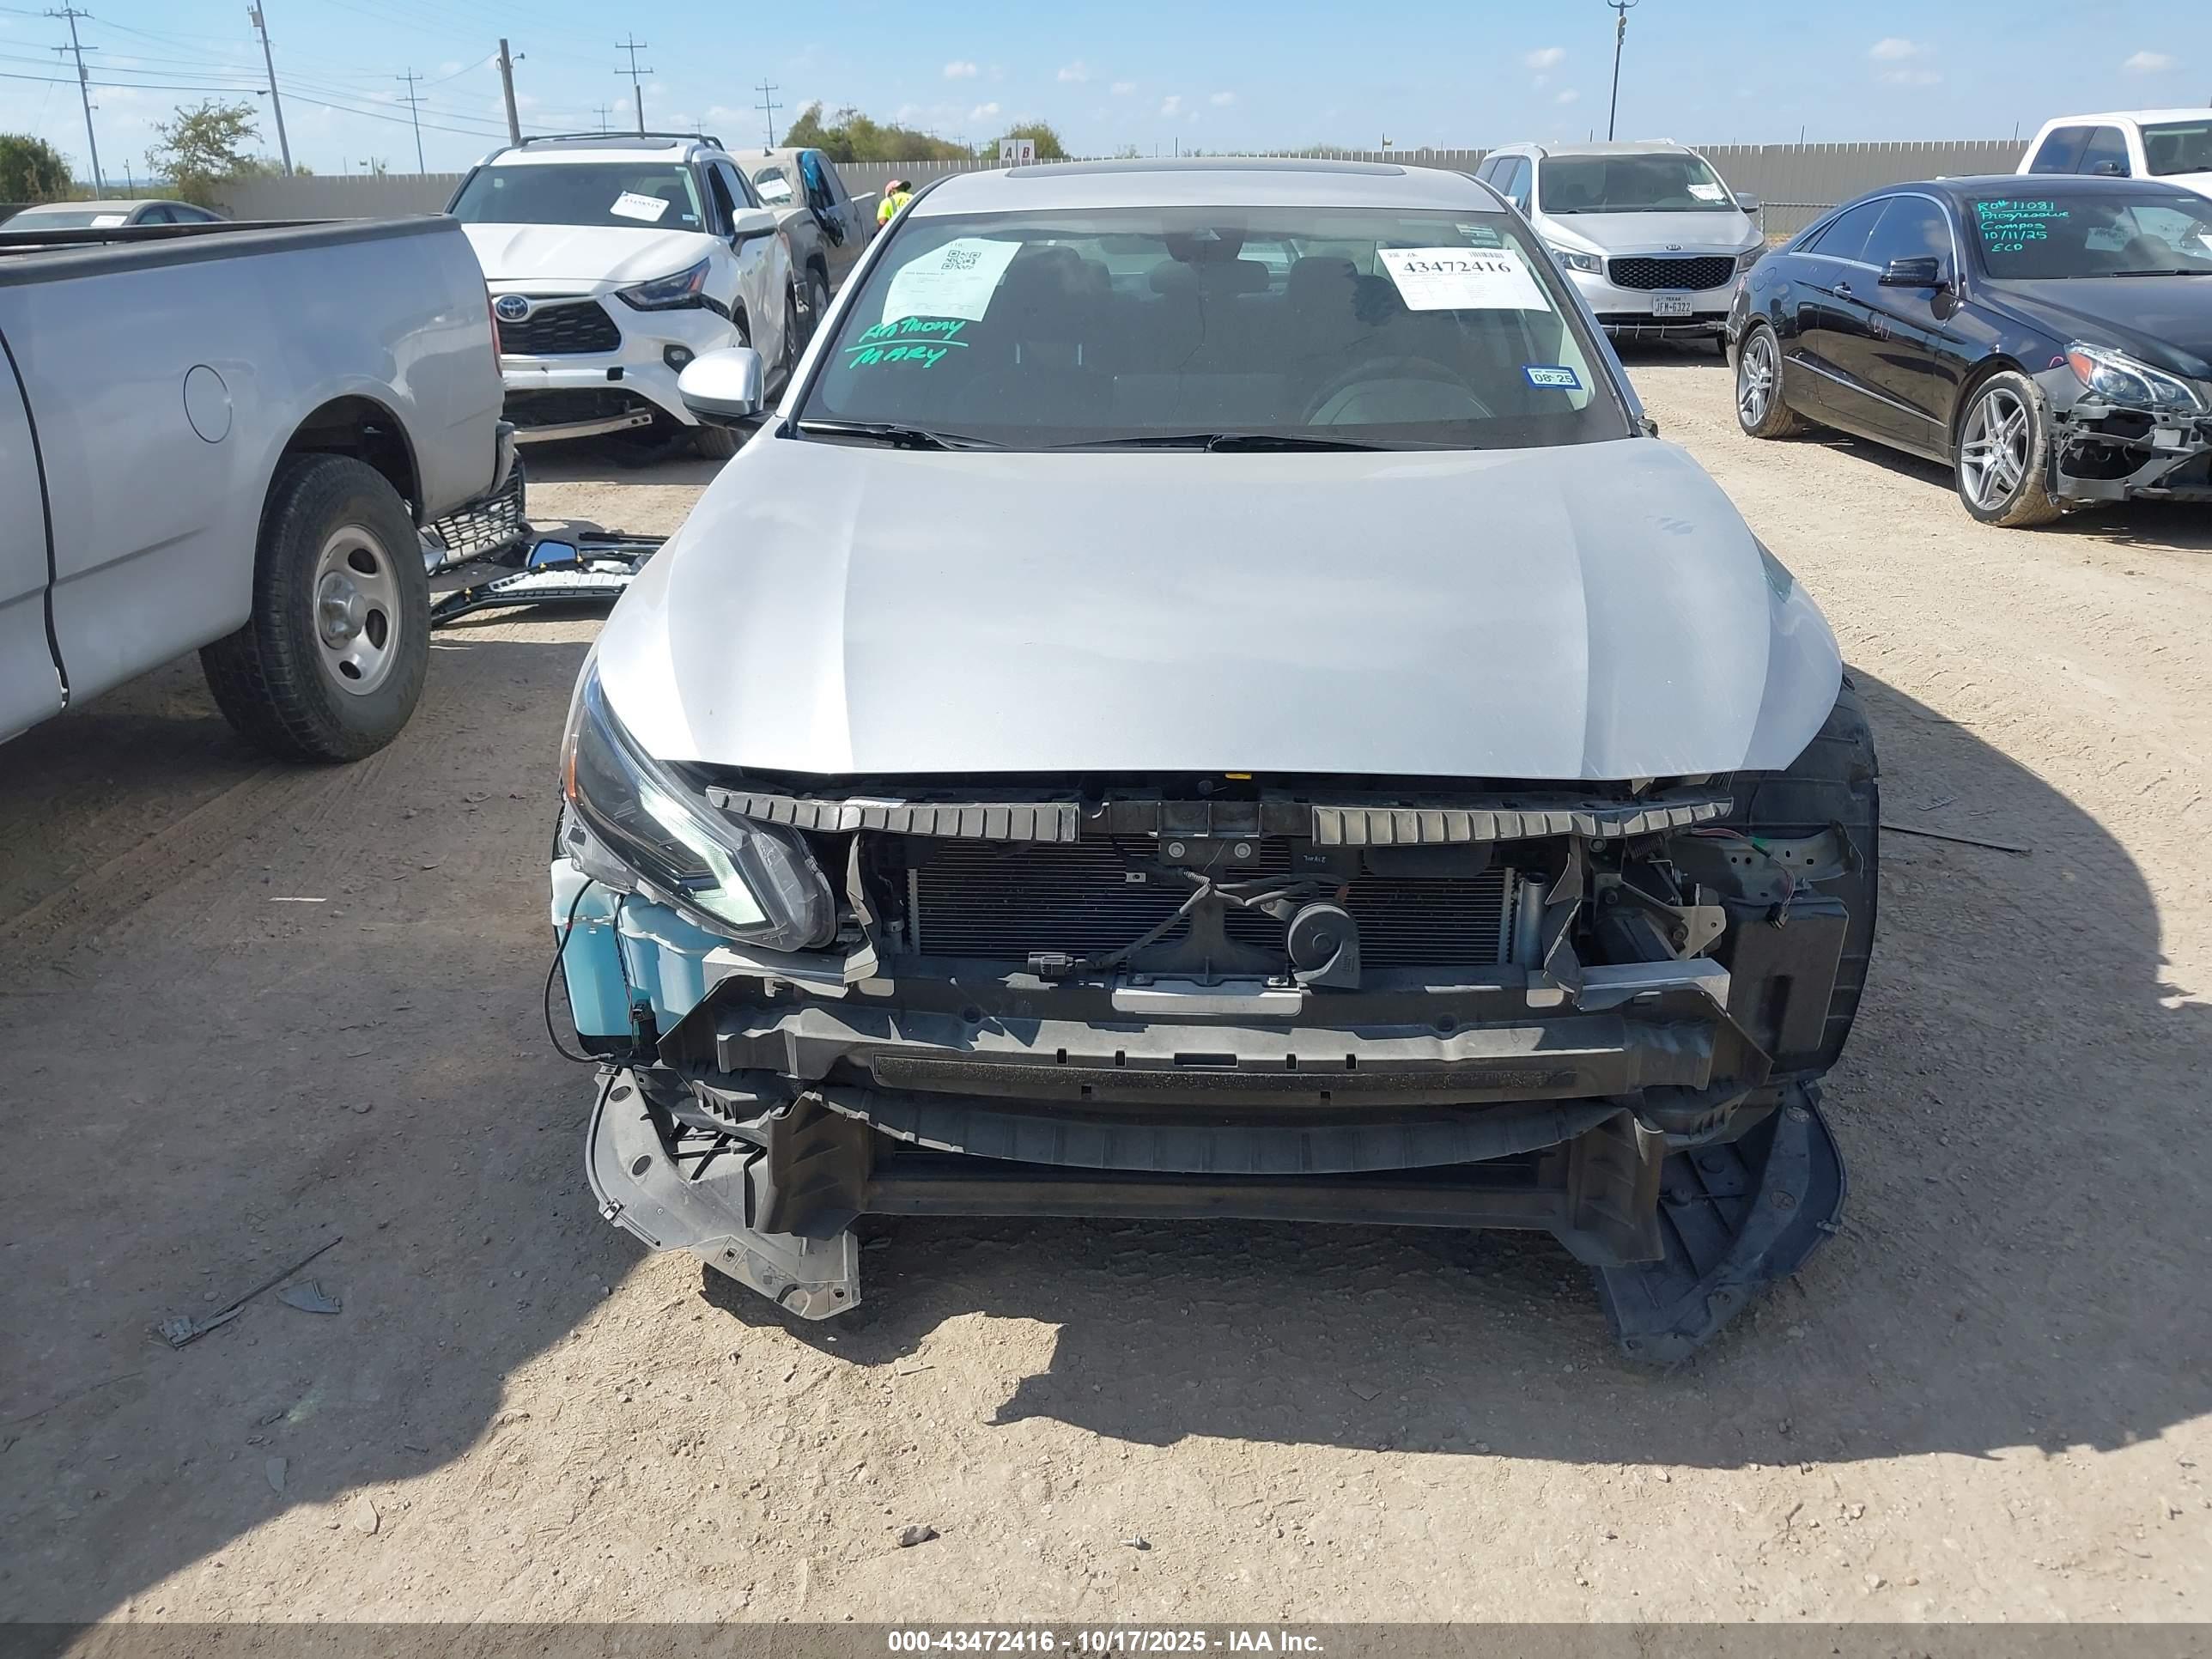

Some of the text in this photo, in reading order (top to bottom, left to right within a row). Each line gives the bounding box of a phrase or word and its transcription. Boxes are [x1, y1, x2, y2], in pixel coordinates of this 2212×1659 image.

[1005, 146, 1012, 159] A
[1022, 146, 1030, 159] B
[1980, 210, 2070, 221] Progressive
[1980, 221, 2046, 231] Campos
[1984, 229, 2048, 241] 10/11/25
[1403, 260, 1511, 273] 43472416
[1556, 374, 1574, 384] 25
